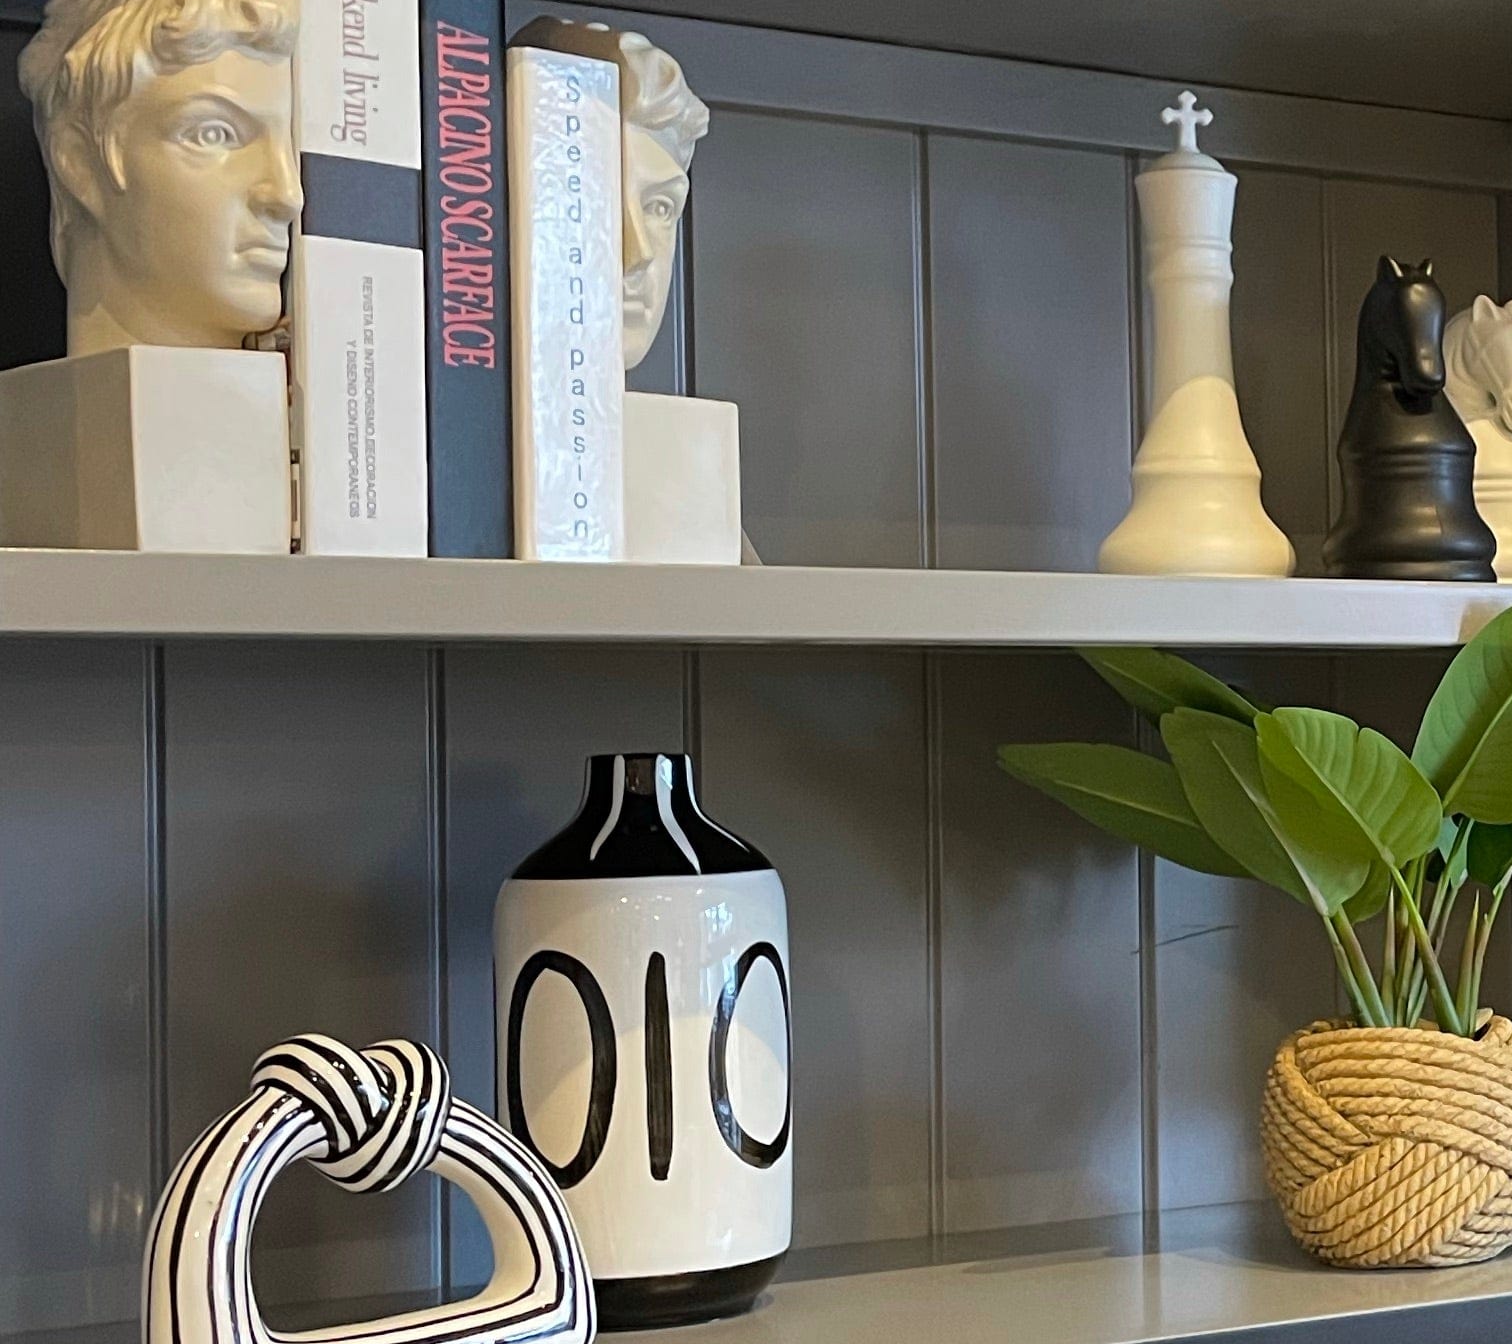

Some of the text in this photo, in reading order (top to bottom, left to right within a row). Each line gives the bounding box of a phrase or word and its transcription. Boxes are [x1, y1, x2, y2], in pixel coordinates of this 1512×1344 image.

[330, 64, 379, 145] living
[440, 196, 495, 369] SCARFACE
[566, 75, 588, 538] Speed and passion
